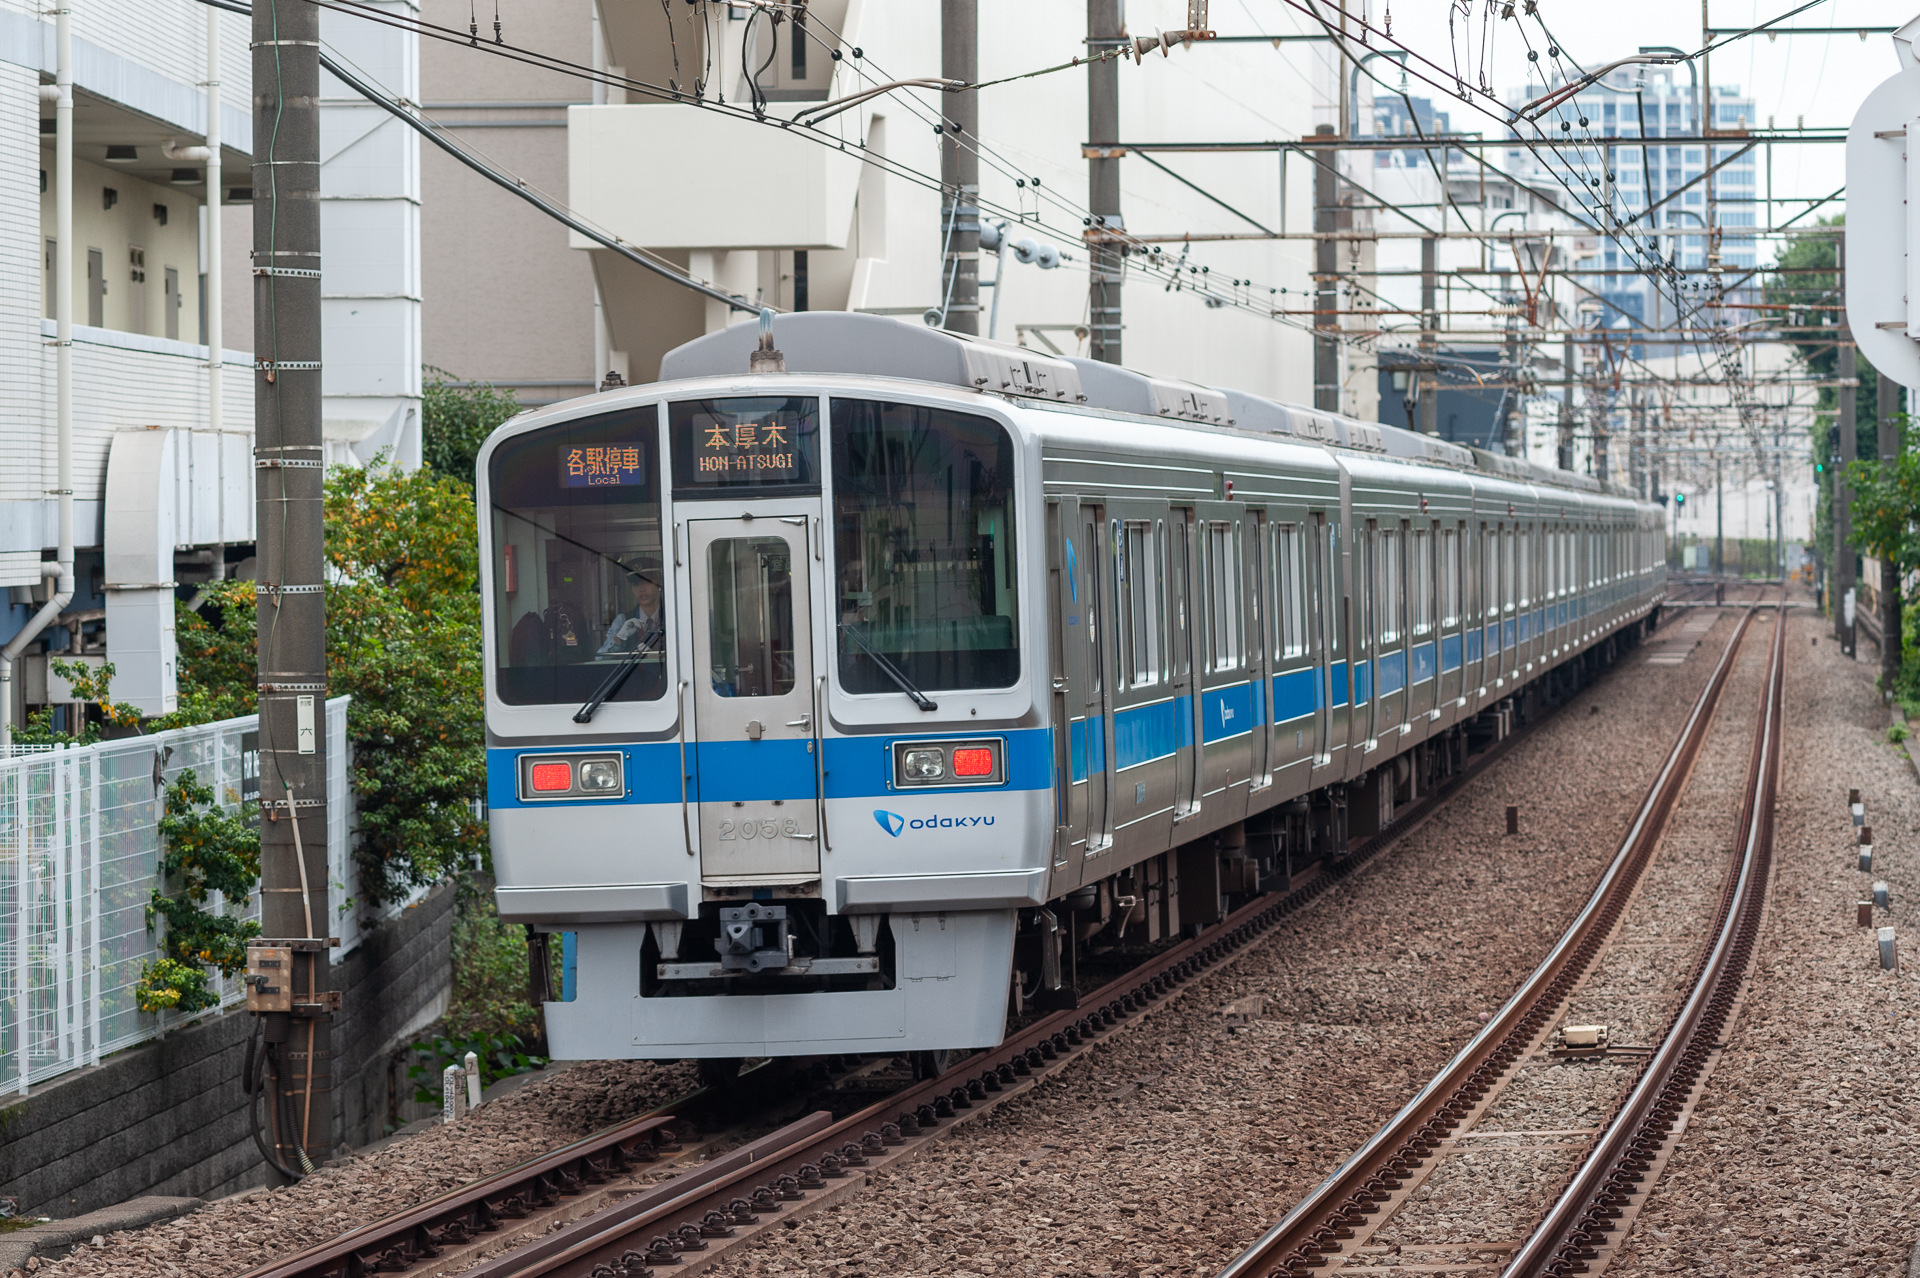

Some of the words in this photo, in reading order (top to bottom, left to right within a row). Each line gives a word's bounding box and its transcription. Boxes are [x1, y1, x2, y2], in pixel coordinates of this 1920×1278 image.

[704, 421, 788, 451] 本厚木
[566, 446, 640, 476] 各駅停車
[699, 453, 793, 472] HON-ATSUGI
[588, 475, 620, 486] Local
[719, 816, 800, 841] 2058
[909, 814, 995, 829] odakyu
